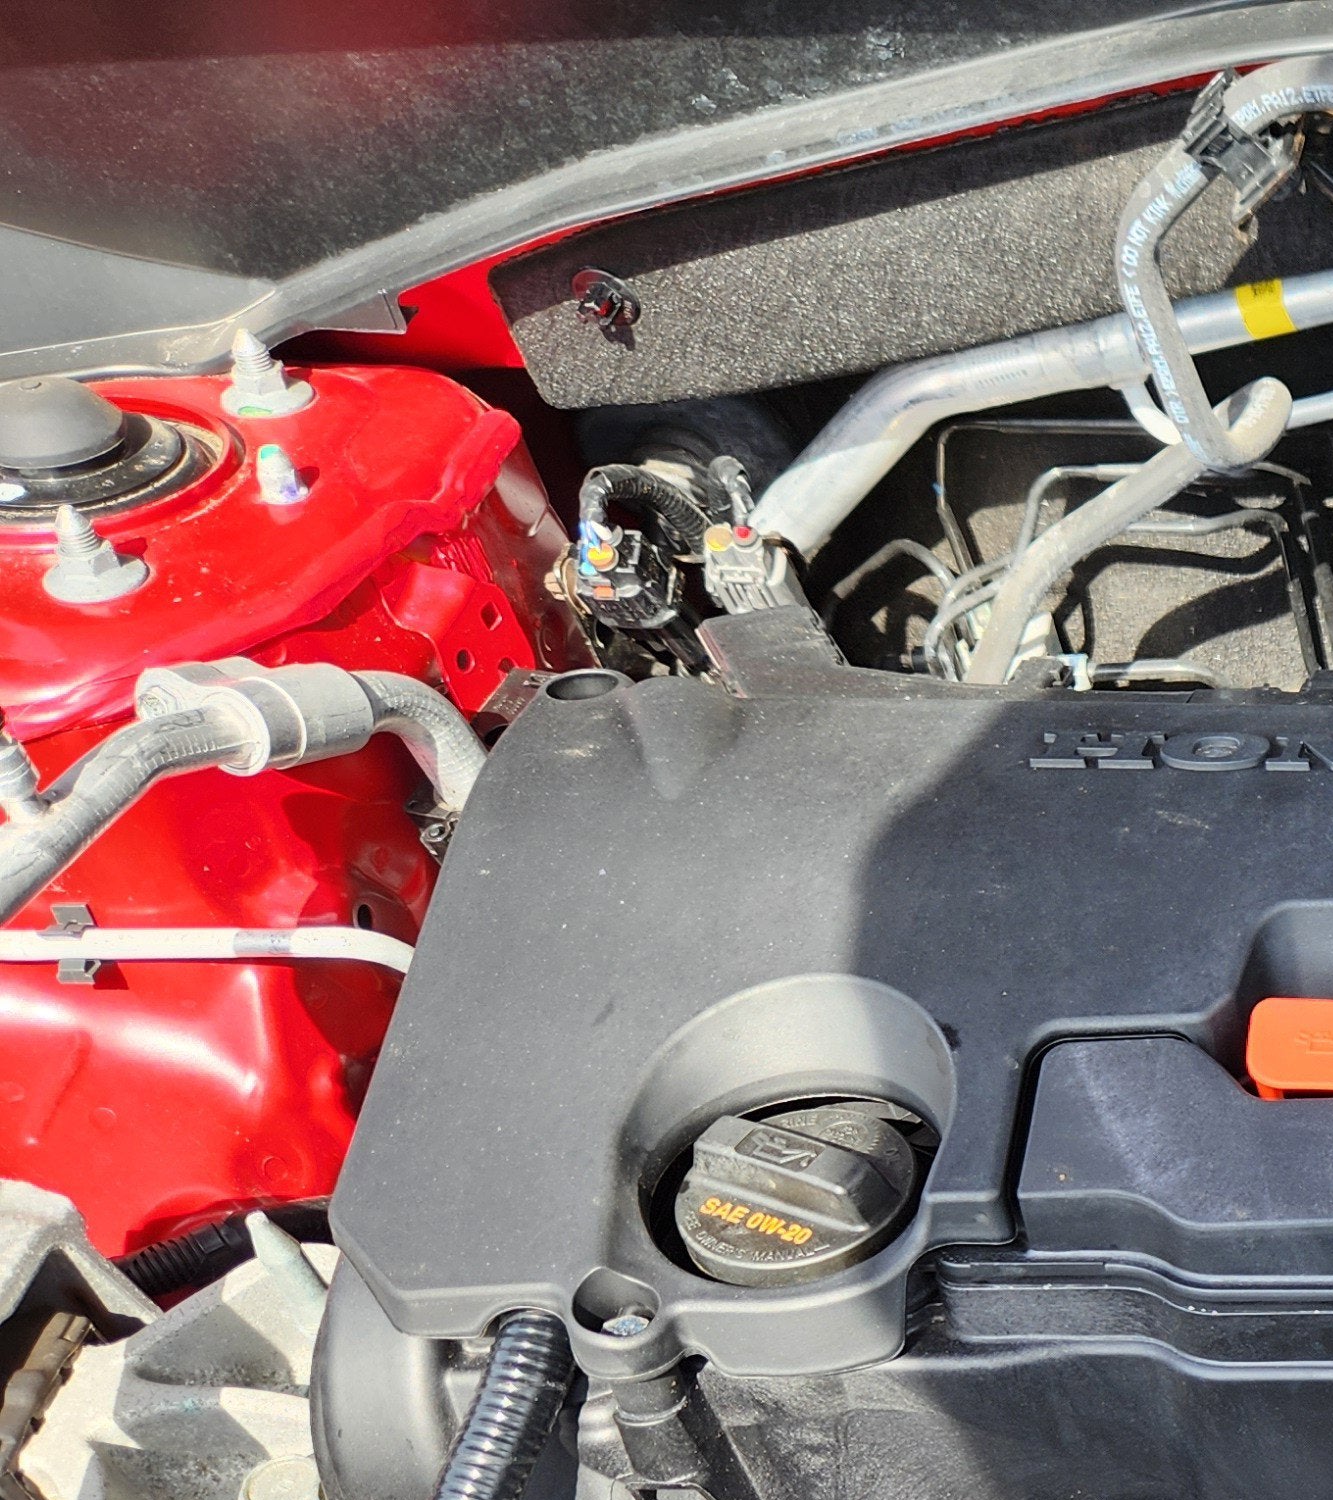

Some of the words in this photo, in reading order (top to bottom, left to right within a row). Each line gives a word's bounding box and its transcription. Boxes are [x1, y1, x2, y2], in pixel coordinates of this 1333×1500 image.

[700, 1197, 750, 1224] SAE
[745, 1211, 813, 1245] 0W-20
[752, 1243, 817, 1262] MANUAL
